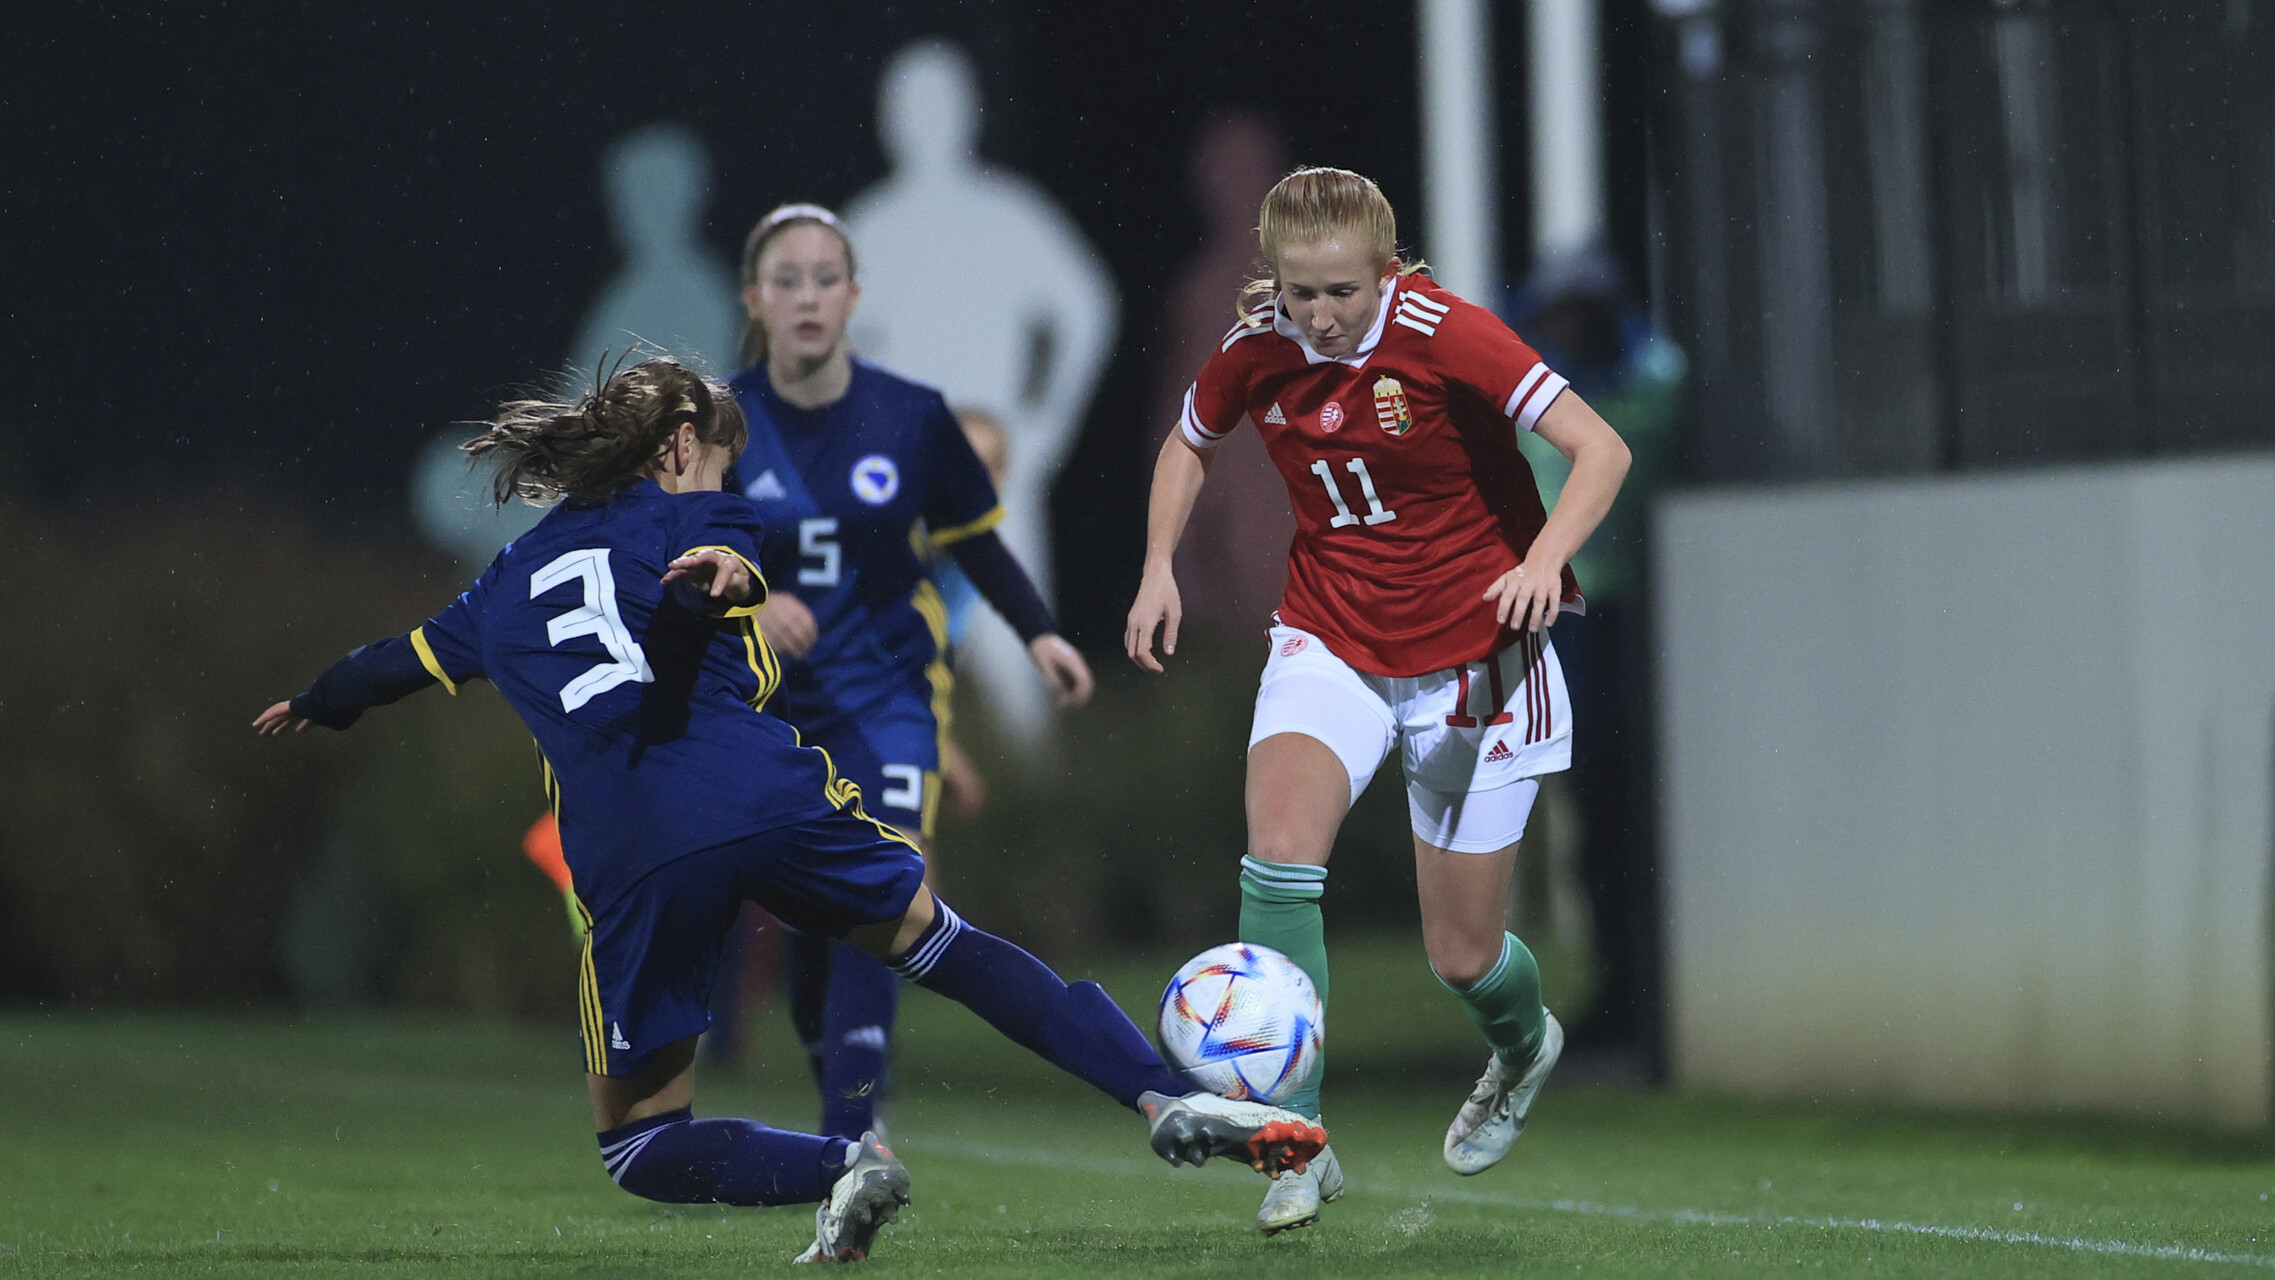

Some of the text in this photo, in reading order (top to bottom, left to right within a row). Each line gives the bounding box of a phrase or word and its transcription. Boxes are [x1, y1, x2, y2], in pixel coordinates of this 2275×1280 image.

[1264, 415, 1287, 425] adidas
[1310, 457, 1397, 529] 11
[797, 518, 841, 587] 5
[529, 547, 655, 714] 3
[1483, 751, 1514, 763] adidas
